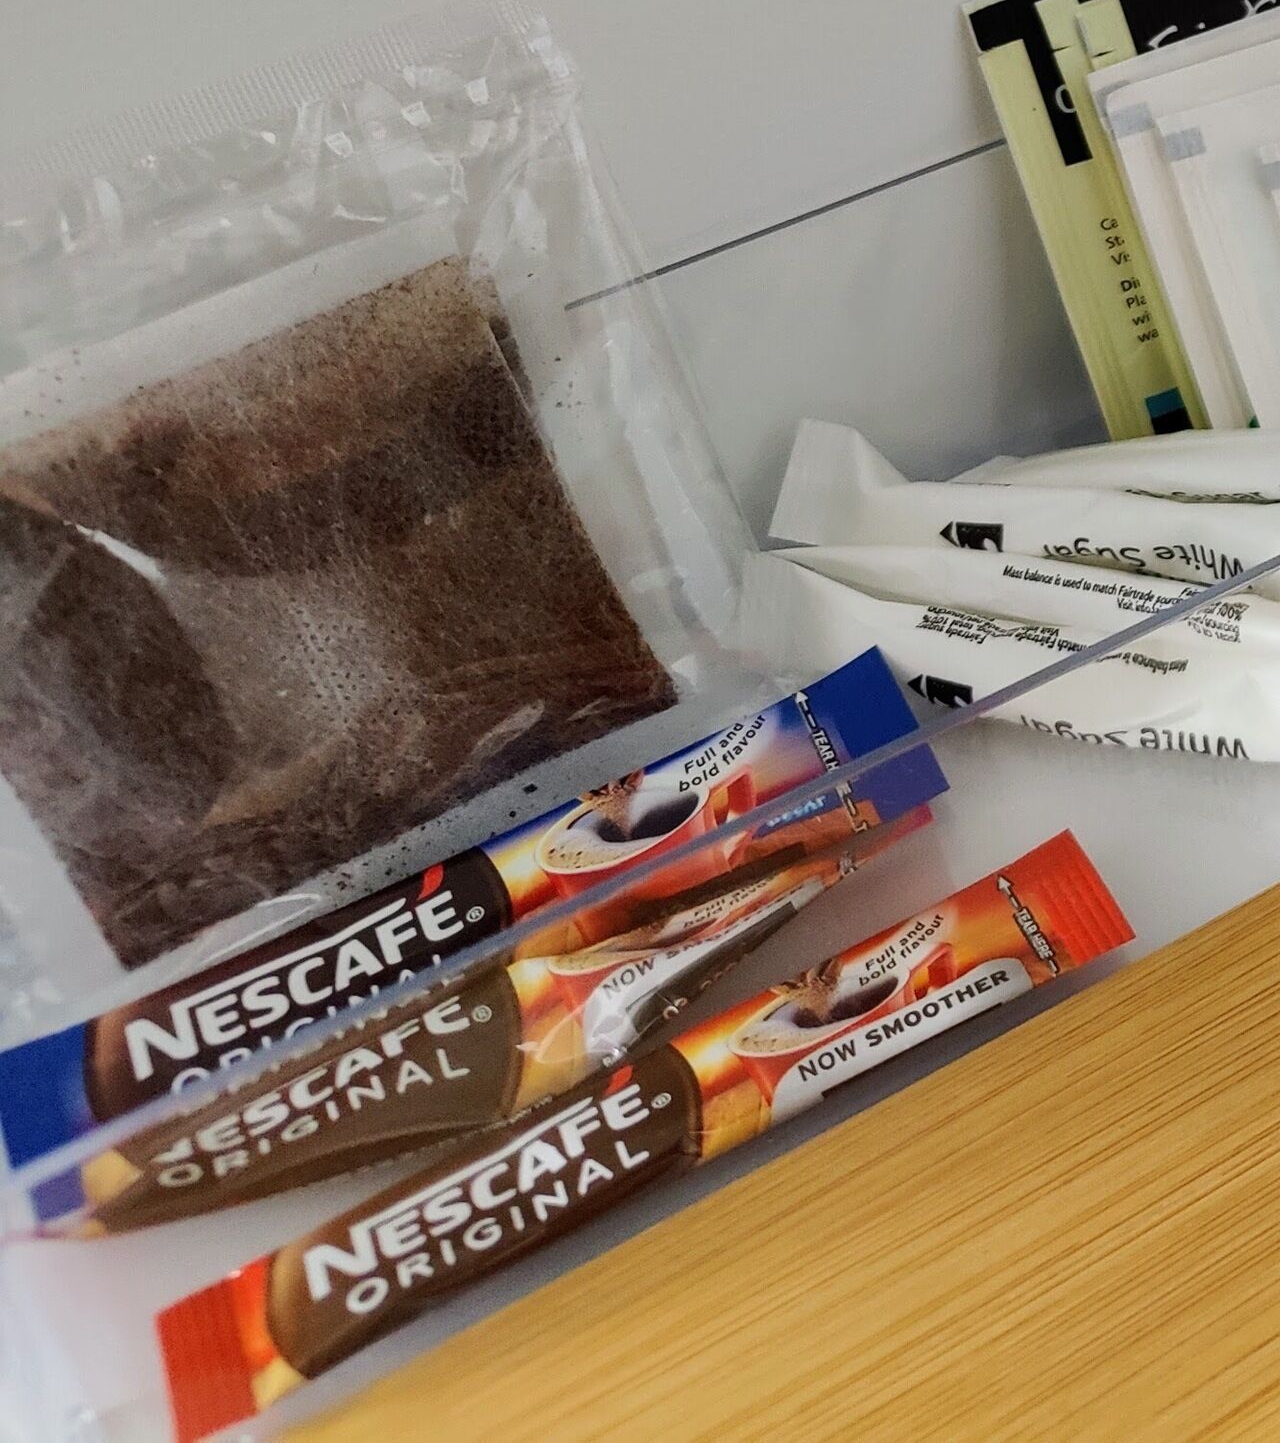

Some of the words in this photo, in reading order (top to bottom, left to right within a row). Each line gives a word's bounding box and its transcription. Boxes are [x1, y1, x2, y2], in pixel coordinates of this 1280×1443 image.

[1003, 565, 1024, 579] Mass
[1024, 569, 1054, 585] balance
[1056, 574, 1062, 586] is
[1062, 577, 1082, 590] used
[1083, 580, 1091, 590] to
[1093, 581, 1118, 596] match
[1118, 585, 1155, 603] Fairtrade
[1153, 544, 1243, 579] White
[678, 767, 720, 793] bold
[721, 714, 767, 766] flavour
[684, 748, 717, 775] Full
[720, 722, 745, 748] and
[812, 730, 835, 762] TEAR
[865, 945, 896, 971] Full
[899, 921, 926, 947] and
[1016, 907, 1038, 937] TEAR
[858, 959, 897, 987] bold
[900, 913, 944, 959] flavour
[602, 953, 657, 999] NOW
[798, 1040, 858, 1082] NOW
[865, 969, 1010, 1047] SMOOTHER
[345, 1141, 650, 1314] ORIGINAL
